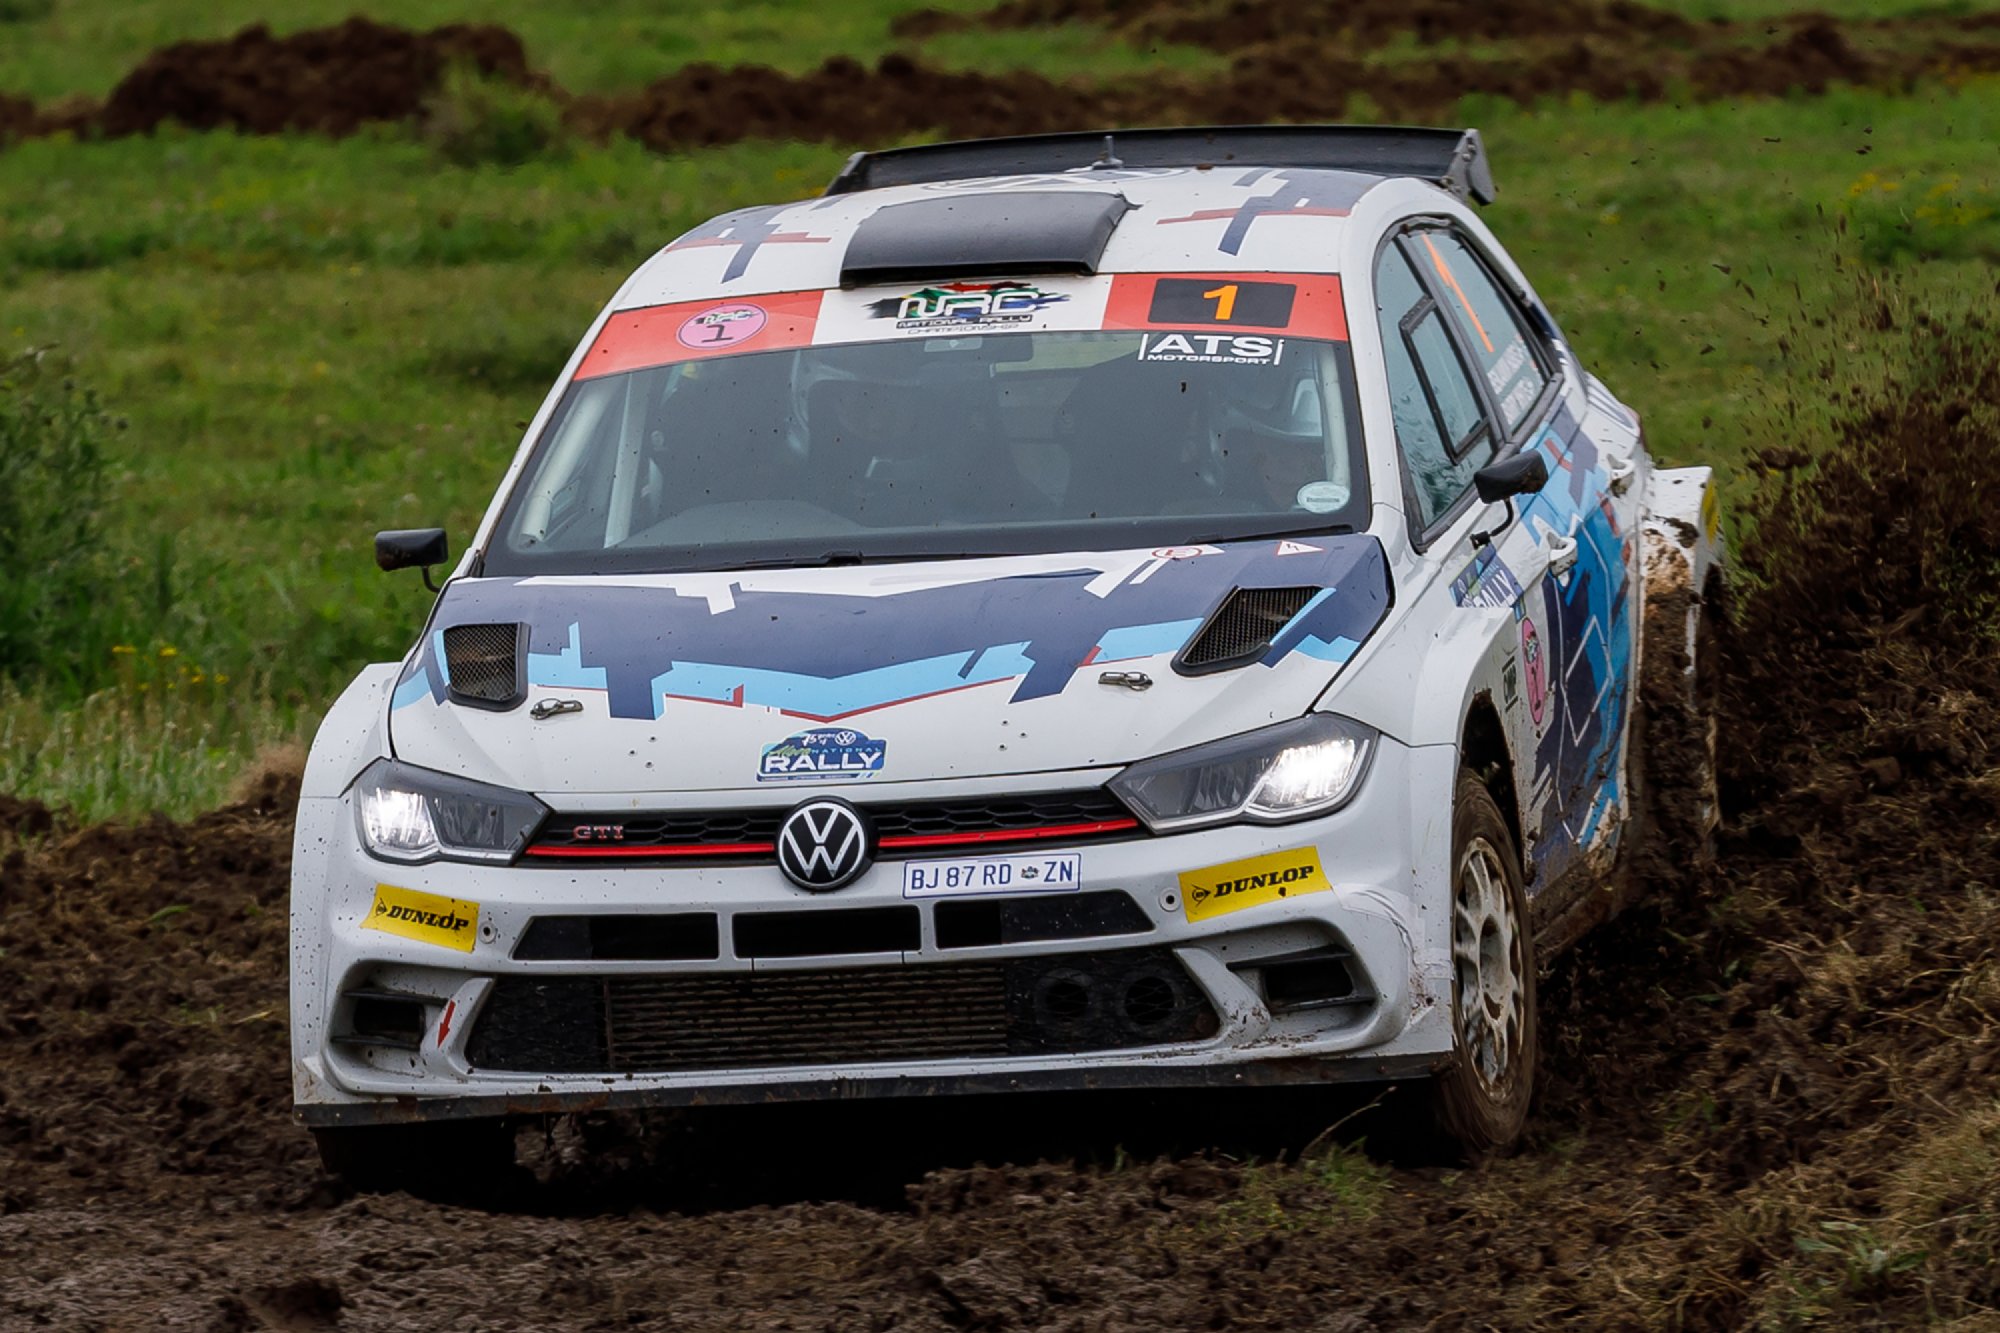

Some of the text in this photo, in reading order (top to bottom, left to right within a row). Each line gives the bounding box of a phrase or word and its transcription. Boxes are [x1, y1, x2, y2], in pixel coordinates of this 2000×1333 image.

[897, 292, 1040, 319] NRC
[1203, 284, 1239, 321] 1
[898, 314, 1031, 329] NATIONAL RALLY
[907, 323, 1019, 335] CHAMPIONSHIP
[701, 323, 734, 344] 1
[1149, 333, 1273, 357] ATS
[1147, 354, 1271, 365] MOTORSPORT
[801, 733, 817, 747] 75
[764, 751, 882, 773] RALLY
[572, 825, 625, 840] GTI
[911, 860, 1073, 890] BJ 87 RD ZN
[1213, 865, 1315, 898] DUNLOP
[386, 904, 470, 931] DUNLOP
